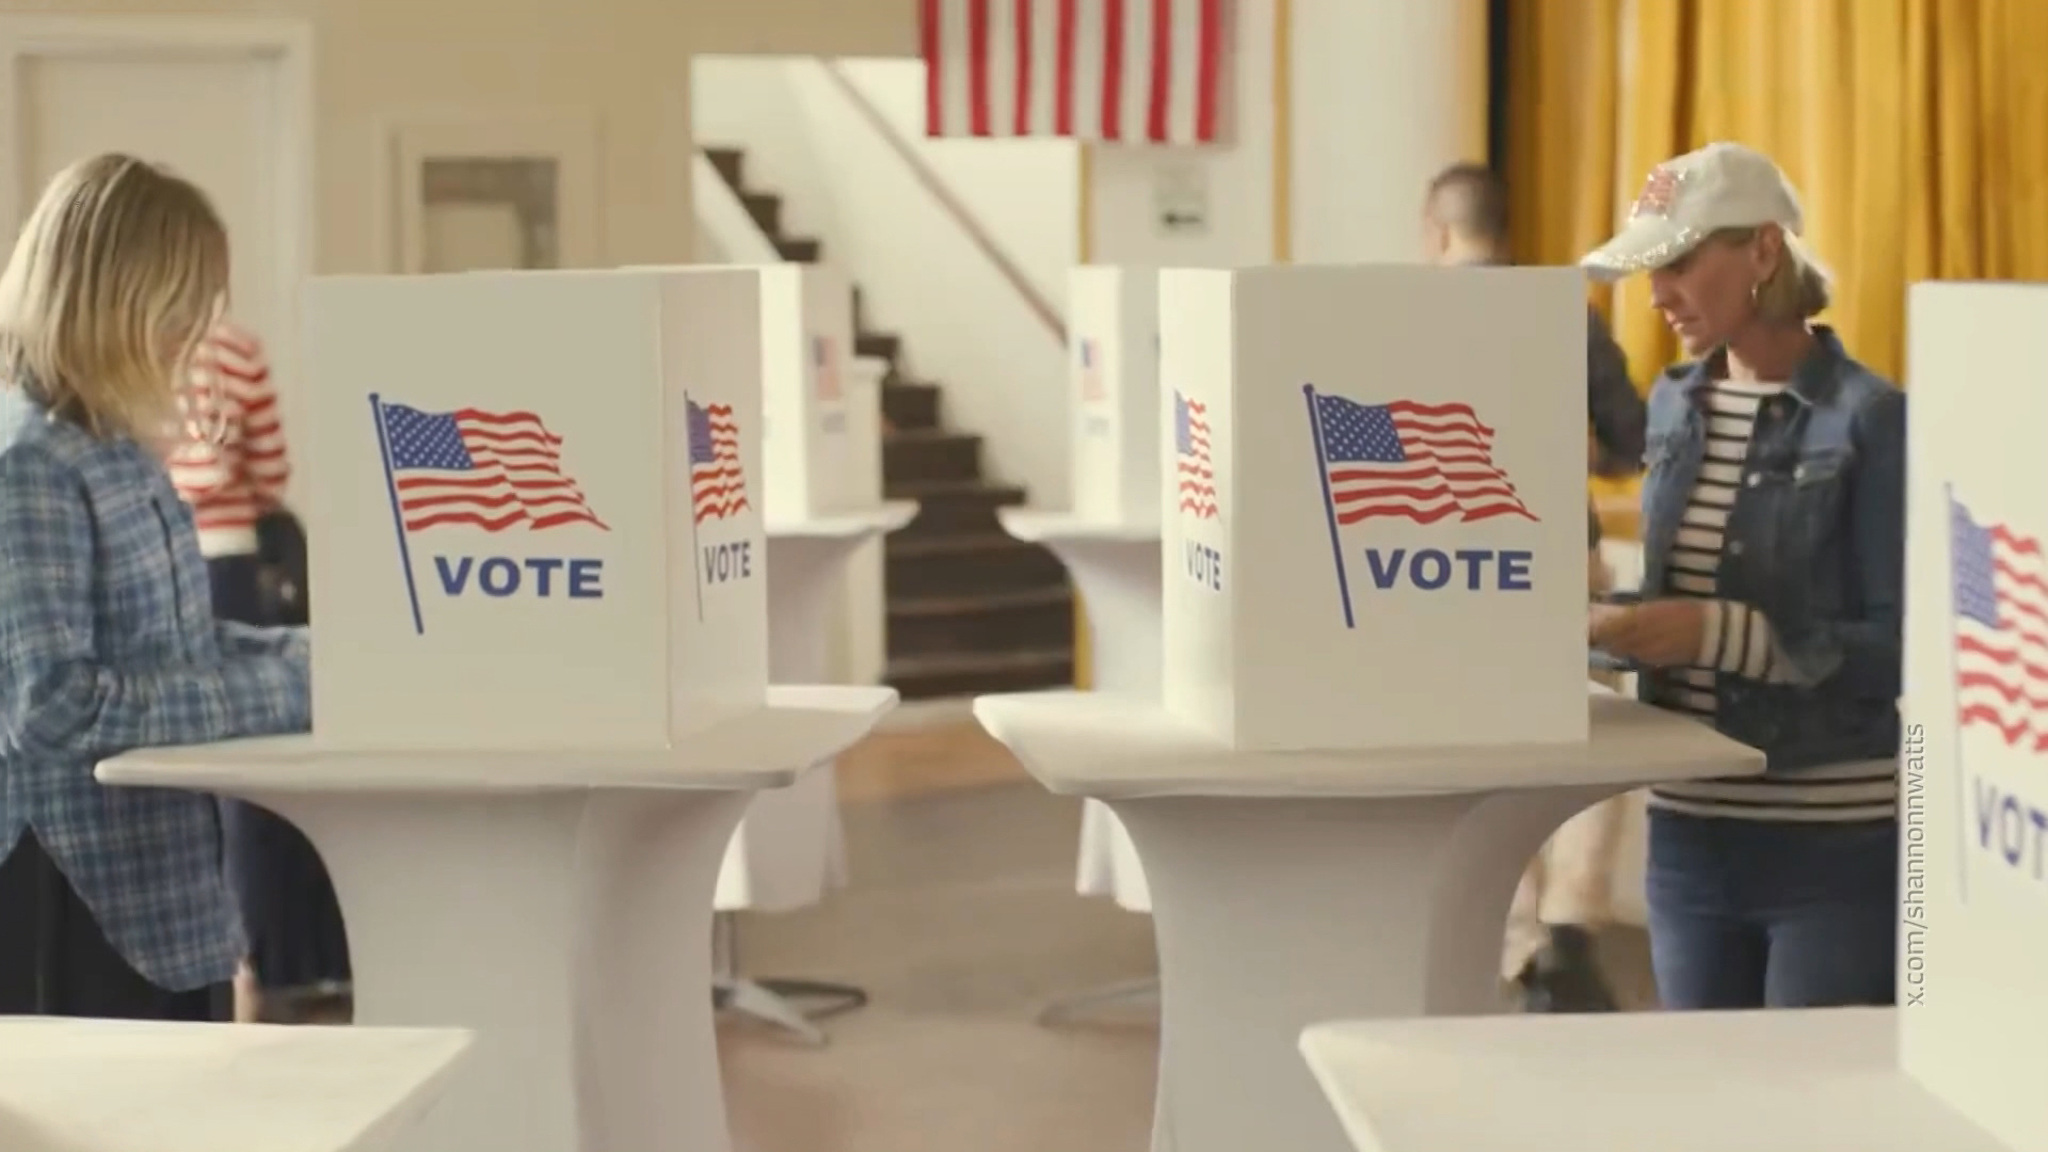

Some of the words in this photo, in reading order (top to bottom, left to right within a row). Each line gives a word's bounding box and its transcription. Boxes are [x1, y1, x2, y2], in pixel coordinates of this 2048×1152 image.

[434, 556, 603, 598] VOTE
[704, 541, 751, 585] VOTE
[1185, 538, 1221, 591] VOTE
[1365, 548, 1533, 591] VOTE
